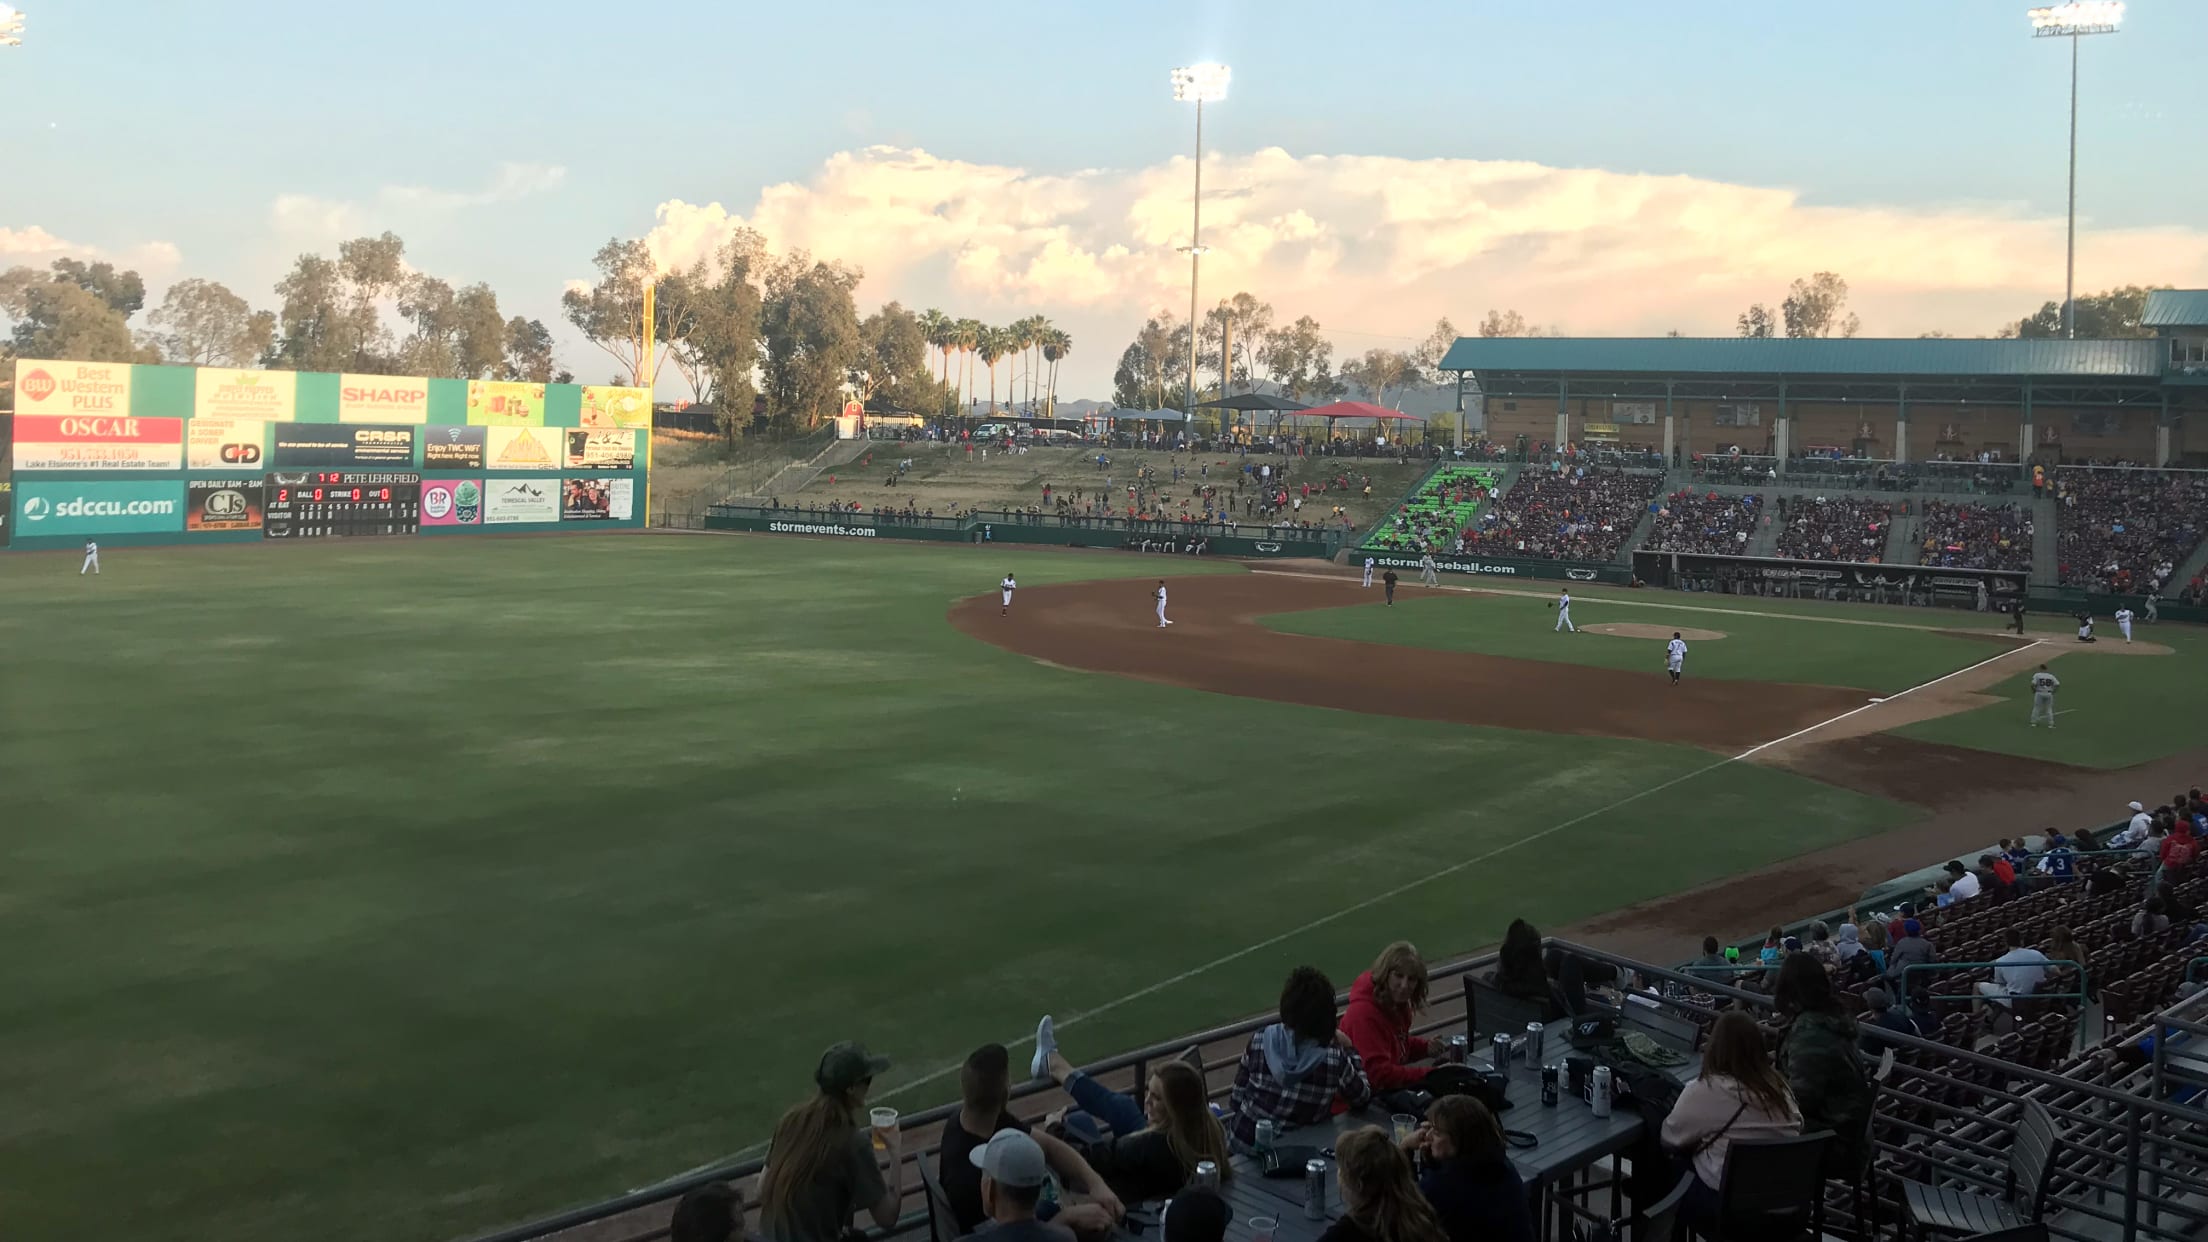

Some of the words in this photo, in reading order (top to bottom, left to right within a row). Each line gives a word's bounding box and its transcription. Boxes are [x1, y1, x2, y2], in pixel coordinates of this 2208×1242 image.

[77, 367, 111, 380] Best
[61, 380, 124, 394] Western
[342, 387, 425, 403] SHARP
[73, 395, 113, 409] PLUS
[60, 417, 140, 436] OSCAR
[355, 430, 411, 442] CASA
[427, 444, 447, 453] Enjoy
[26, 460, 46, 468] Lake
[102, 460, 119, 468] Real
[121, 460, 146, 468] Estate
[189, 481, 206, 489] OPEN
[207, 480, 226, 488] DAILY
[344, 474, 367, 483] PETE
[368, 474, 393, 483] LEHR
[393, 474, 419, 483] FIELD
[279, 489, 288, 501] 2
[314, 488, 323, 500] 0
[352, 488, 361, 500] 0
[381, 488, 389, 500] 0
[56, 497, 173, 517] sdccu.com
[770, 521, 875, 536] stormevents.com
[2056, 857, 2066, 870] 3
